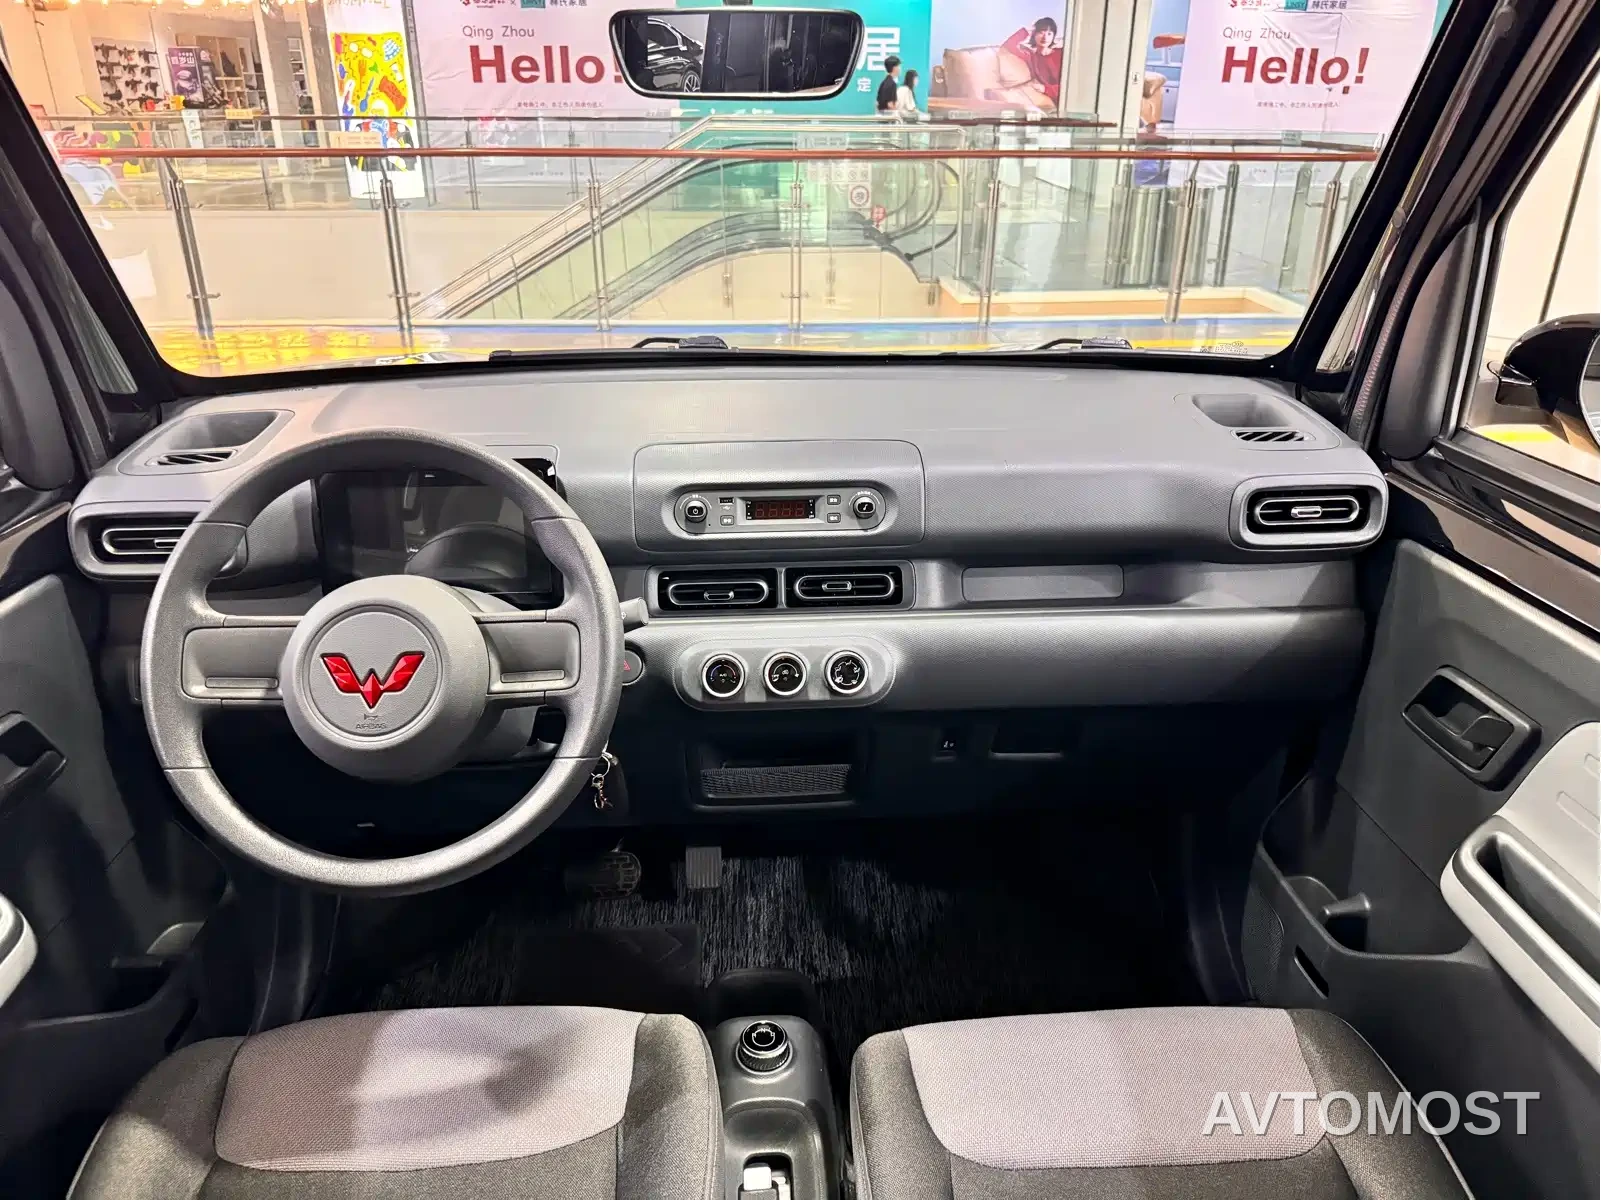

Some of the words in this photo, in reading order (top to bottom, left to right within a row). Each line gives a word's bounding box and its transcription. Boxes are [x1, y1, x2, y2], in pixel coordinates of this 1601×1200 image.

[462, 26, 494, 40] Qing
[501, 26, 535, 38] Zhou
[1222, 27, 1252, 41] Qing
[1260, 28, 1291, 39] Zhou
[1221, 46, 1370, 85] Hello!
